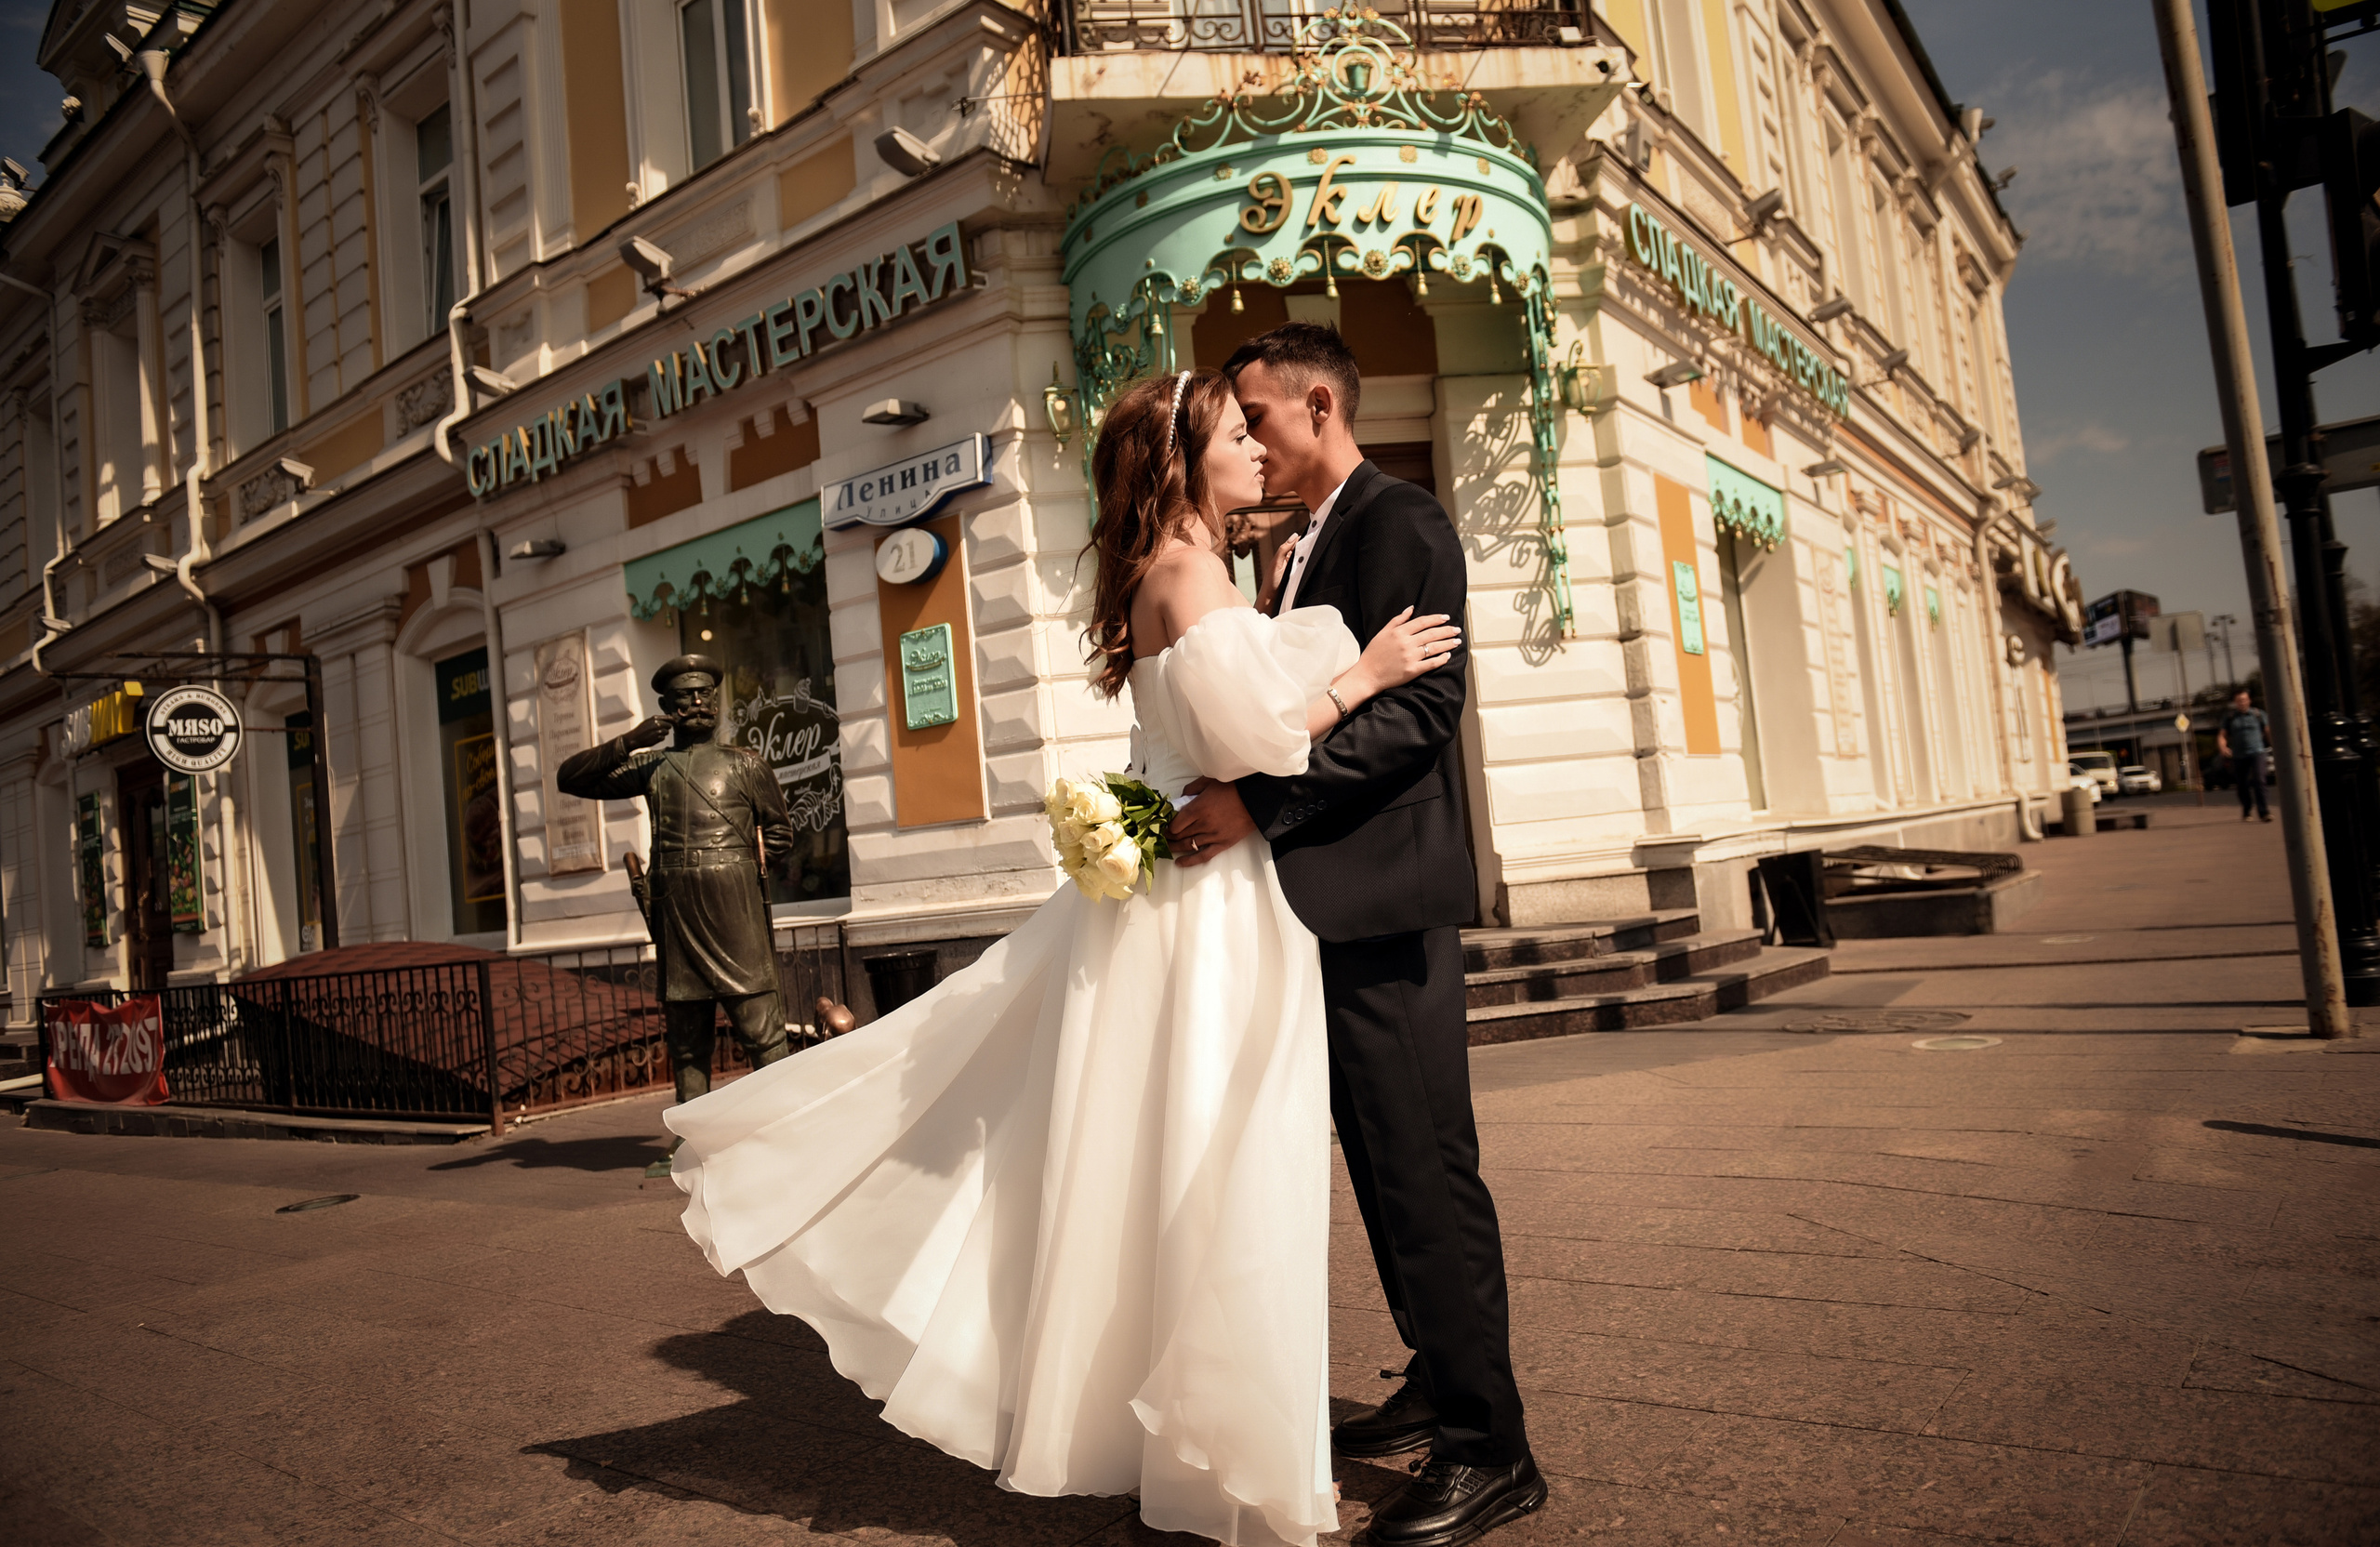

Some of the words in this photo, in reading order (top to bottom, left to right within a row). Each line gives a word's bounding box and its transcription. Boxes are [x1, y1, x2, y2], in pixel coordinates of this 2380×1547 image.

[1239, 155, 1484, 241] Эклер
[1629, 202, 1741, 334] СЛАДКАЯ
[1748, 298, 1849, 417] МАСТЕРСКАЯ
[467, 378, 629, 497] СЛАДКАЯ
[648, 219, 967, 418] МАСТЕРСКАЯ
[838, 452, 962, 510] Ленина
[890, 540, 919, 574] 21
[451, 667, 490, 701] SUBW
[166, 749, 187, 764] HIGH
[192, 747, 226, 766] QUALITY
[747, 711, 821, 761] Эклер
